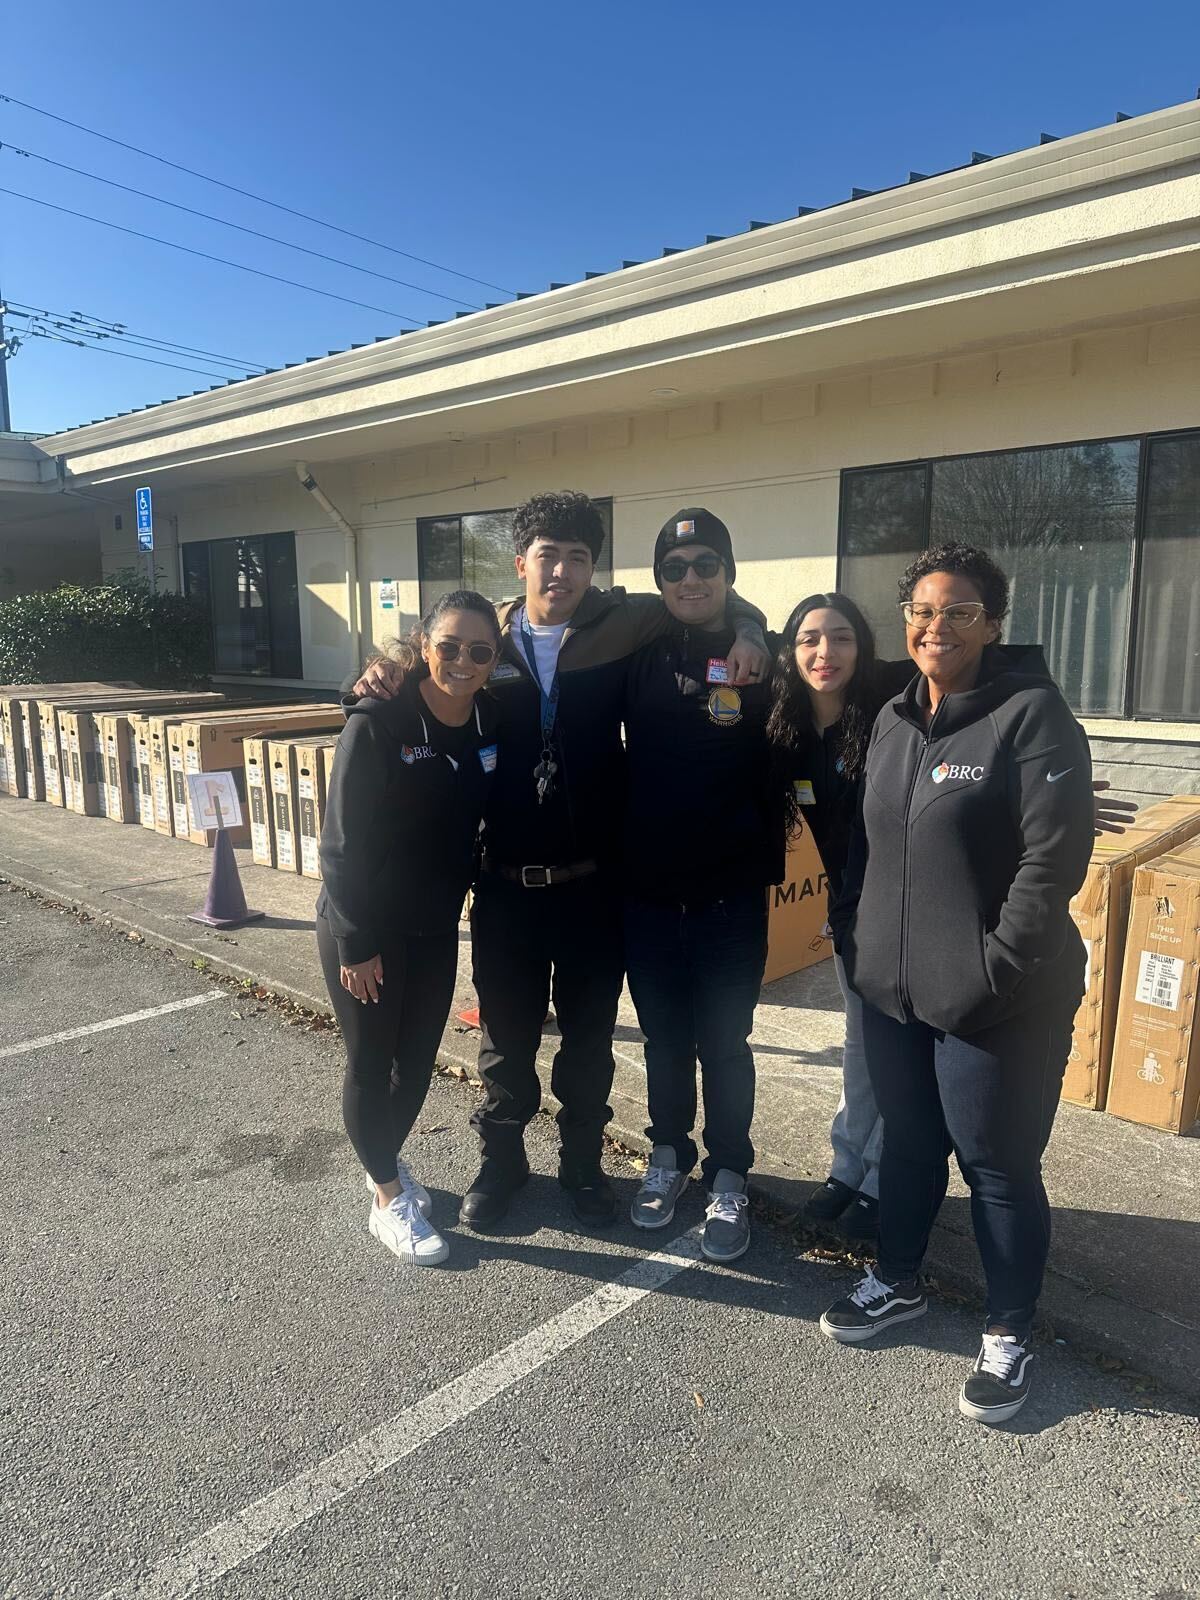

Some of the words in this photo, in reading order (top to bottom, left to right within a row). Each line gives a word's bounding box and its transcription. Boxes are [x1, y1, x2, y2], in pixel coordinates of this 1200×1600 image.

[709, 713, 744, 727] WARRIORS
[947, 765, 984, 781] BRC
[1156, 924, 1175, 934] THIS
[1150, 932, 1168, 942] SIDE
[1169, 936, 1182, 944] UP
[1150, 953, 1175, 966] BRILLIANT
